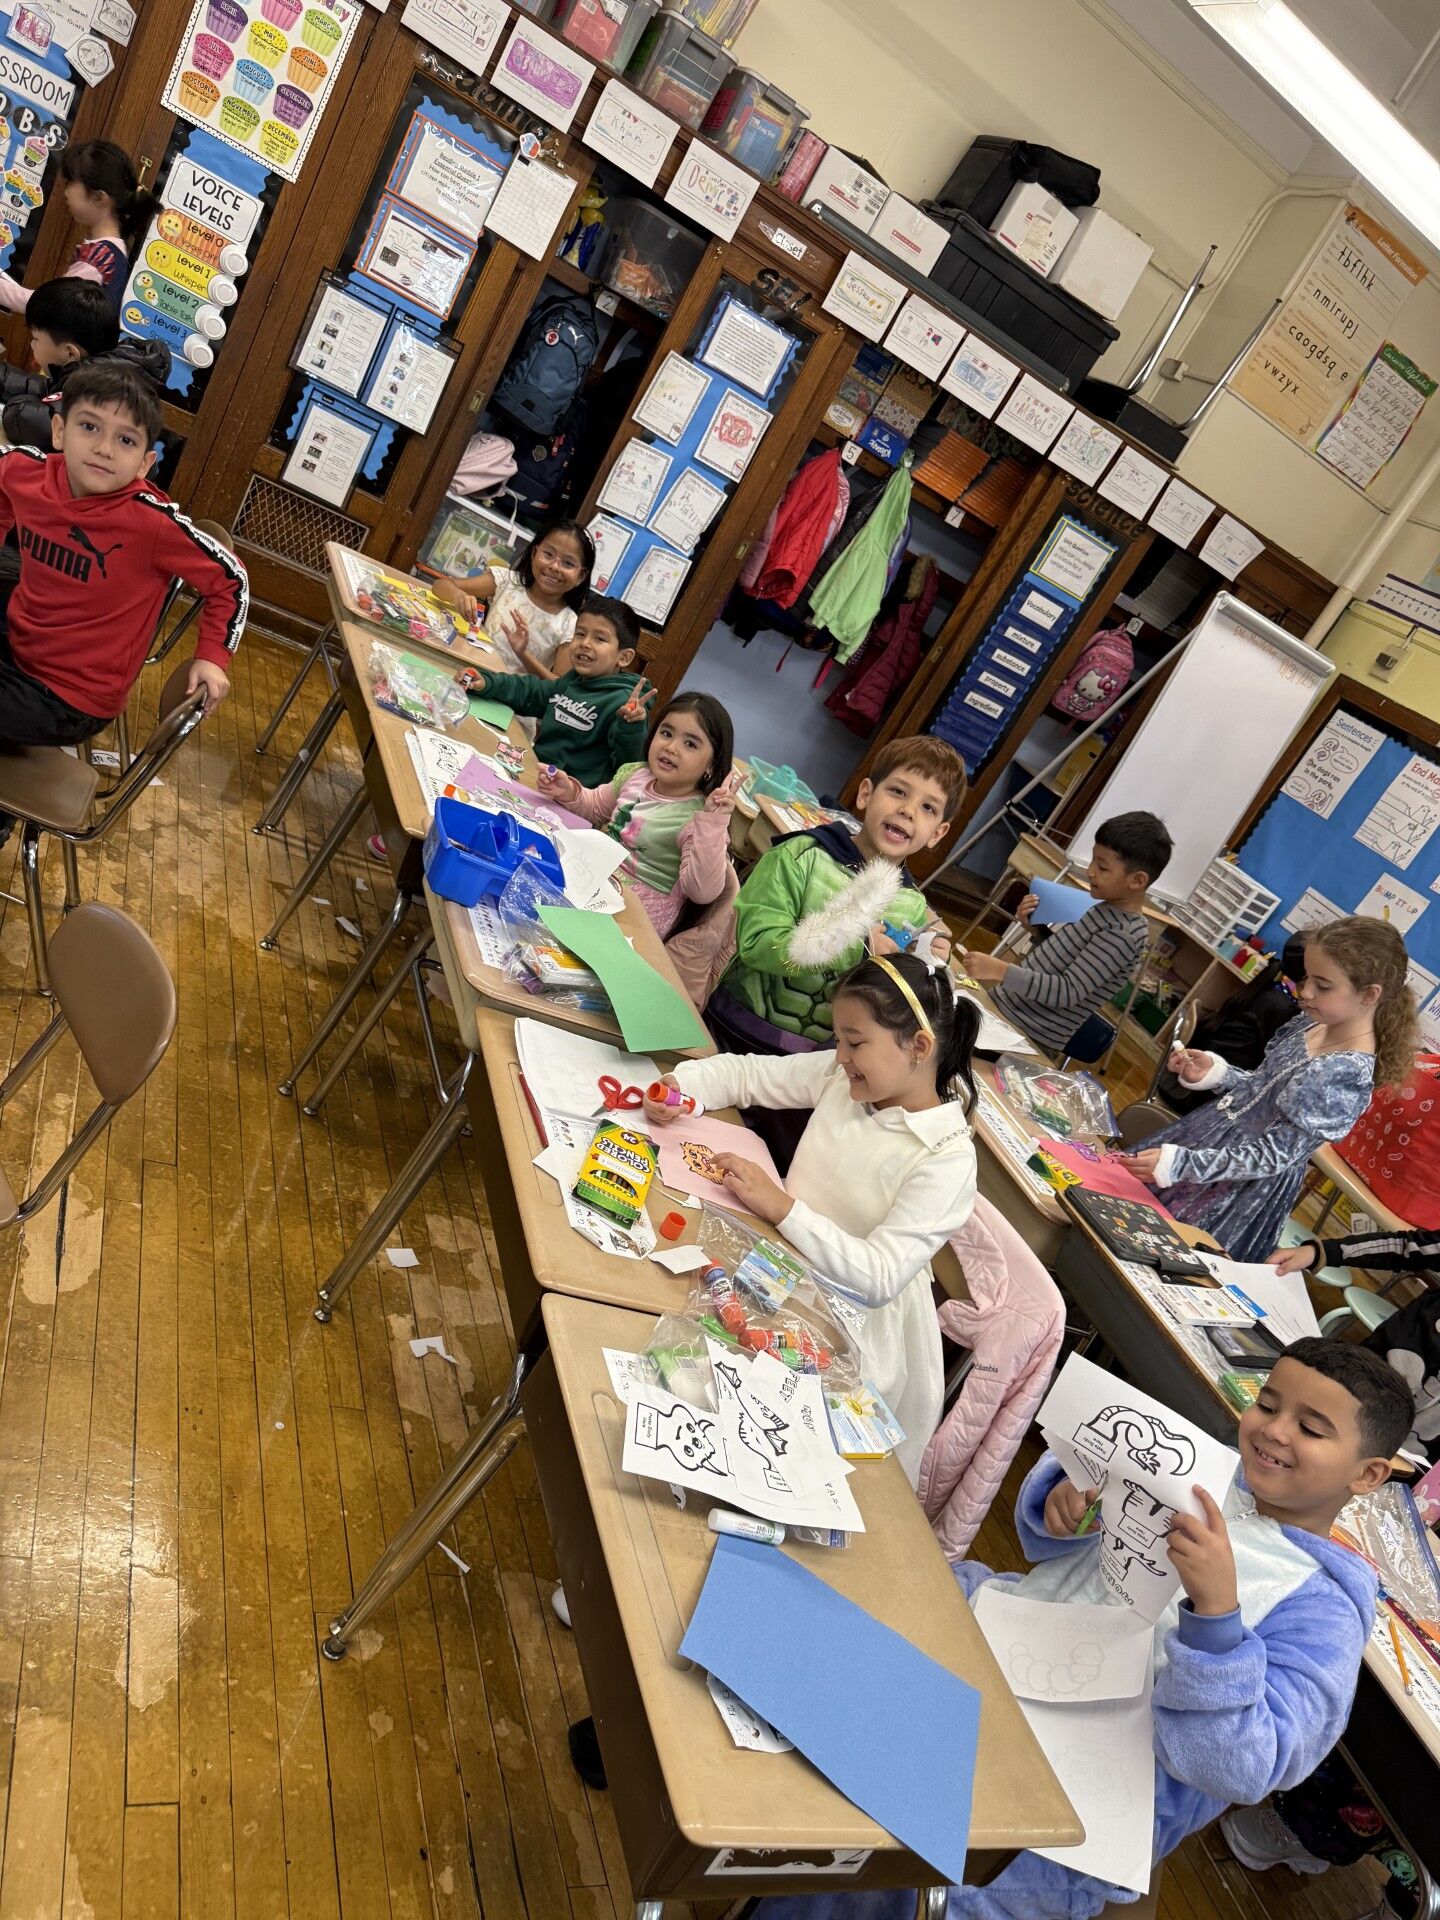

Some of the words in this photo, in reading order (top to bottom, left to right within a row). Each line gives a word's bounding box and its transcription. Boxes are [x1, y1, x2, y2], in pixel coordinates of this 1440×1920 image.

[263, 29, 277, 41] MAY
[208, 41, 222, 54] JULY
[303, 55, 317, 67] JUNE
[244, 64, 267, 80] AUGUST
[188, 75, 215, 94] OCTOBER
[226, 98, 258, 121] NOVEMBER
[267, 123, 295, 145] DECEMBER
[191, 169, 244, 211] VOICE
[183, 192, 234, 231] LEVELS
[187, 221, 217, 244] Level
[772, 231, 806, 258] Closet
[177, 253, 205, 273] Level
[205, 268, 212, 279] 1
[1375, 237, 1397, 256] Letter
[1389, 252, 1422, 280] Formation
[173, 270, 207, 292] Whisper
[163, 283, 192, 304] Level
[192, 299, 199, 309] 2
[601, 295, 611, 311] 2
[158, 298, 179, 316] Table
[153, 315, 180, 334] Level
[180, 329, 187, 339] 3
[844, 443, 855, 460] 5
[950, 511, 961, 523] 7
[21, 525, 93, 584] PUMA
[1026, 598, 1057, 623] Vocabulary
[1011, 630, 1036, 649] mixture
[994, 652, 1026, 673] substance
[984, 674, 1011, 694] property
[968, 696, 999, 716] ingredient
[558, 713, 569, 724] NYC
[1335, 717, 1374, 745] Sentences
[1309, 771, 1319, 781] the
[1316, 765, 1332, 778] dogs
[1330, 774, 1341, 783] ran
[1411, 762, 1429, 778] End
[1375, 884, 1396, 901] BUMP
[1396, 897, 1407, 909] IT
[1406, 902, 1418, 915] UP
[622, 1132, 639, 1145] 24
[595, 1142, 651, 1174] COLORED
[601, 1137, 650, 1166] PENCILS
[593, 1173, 635, 1199] Crayola
[775, 1370, 804, 1404] FEET
[640, 1416, 648, 1428] Here
[1082, 1437, 1095, 1447] Body
[1092, 1437, 1104, 1446] Here
[1093, 1444, 1107, 1455] Paste
[1135, 1526, 1146, 1535] Here
